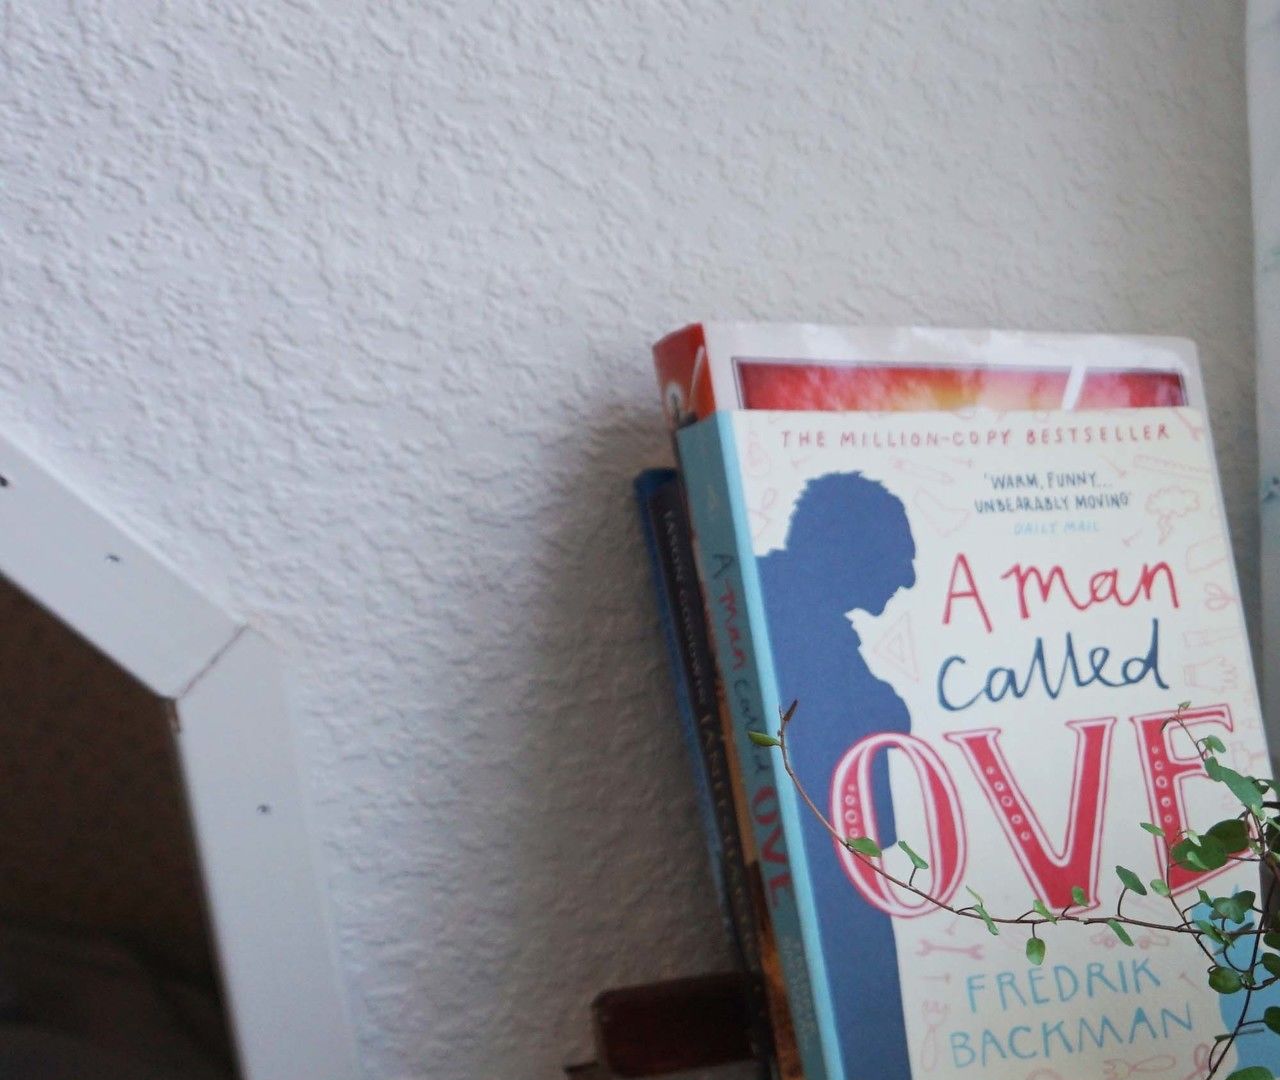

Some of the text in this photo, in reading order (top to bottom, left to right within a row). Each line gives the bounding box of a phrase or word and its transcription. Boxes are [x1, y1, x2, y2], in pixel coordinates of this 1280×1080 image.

[781, 423, 1170, 448] THE MILLION-COPY BESTSELLER
[974, 497, 1070, 514] UNBEARABLY
[1013, 520, 1100, 536] DAILY MAIL
[941, 552, 1181, 634] A man
[712, 553, 736, 580] A
[753, 784, 792, 906] OVE
[829, 703, 1263, 918] OVE
[966, 957, 1161, 1013] FREDRIK
[951, 1003, 1193, 1068] BACKMAN
